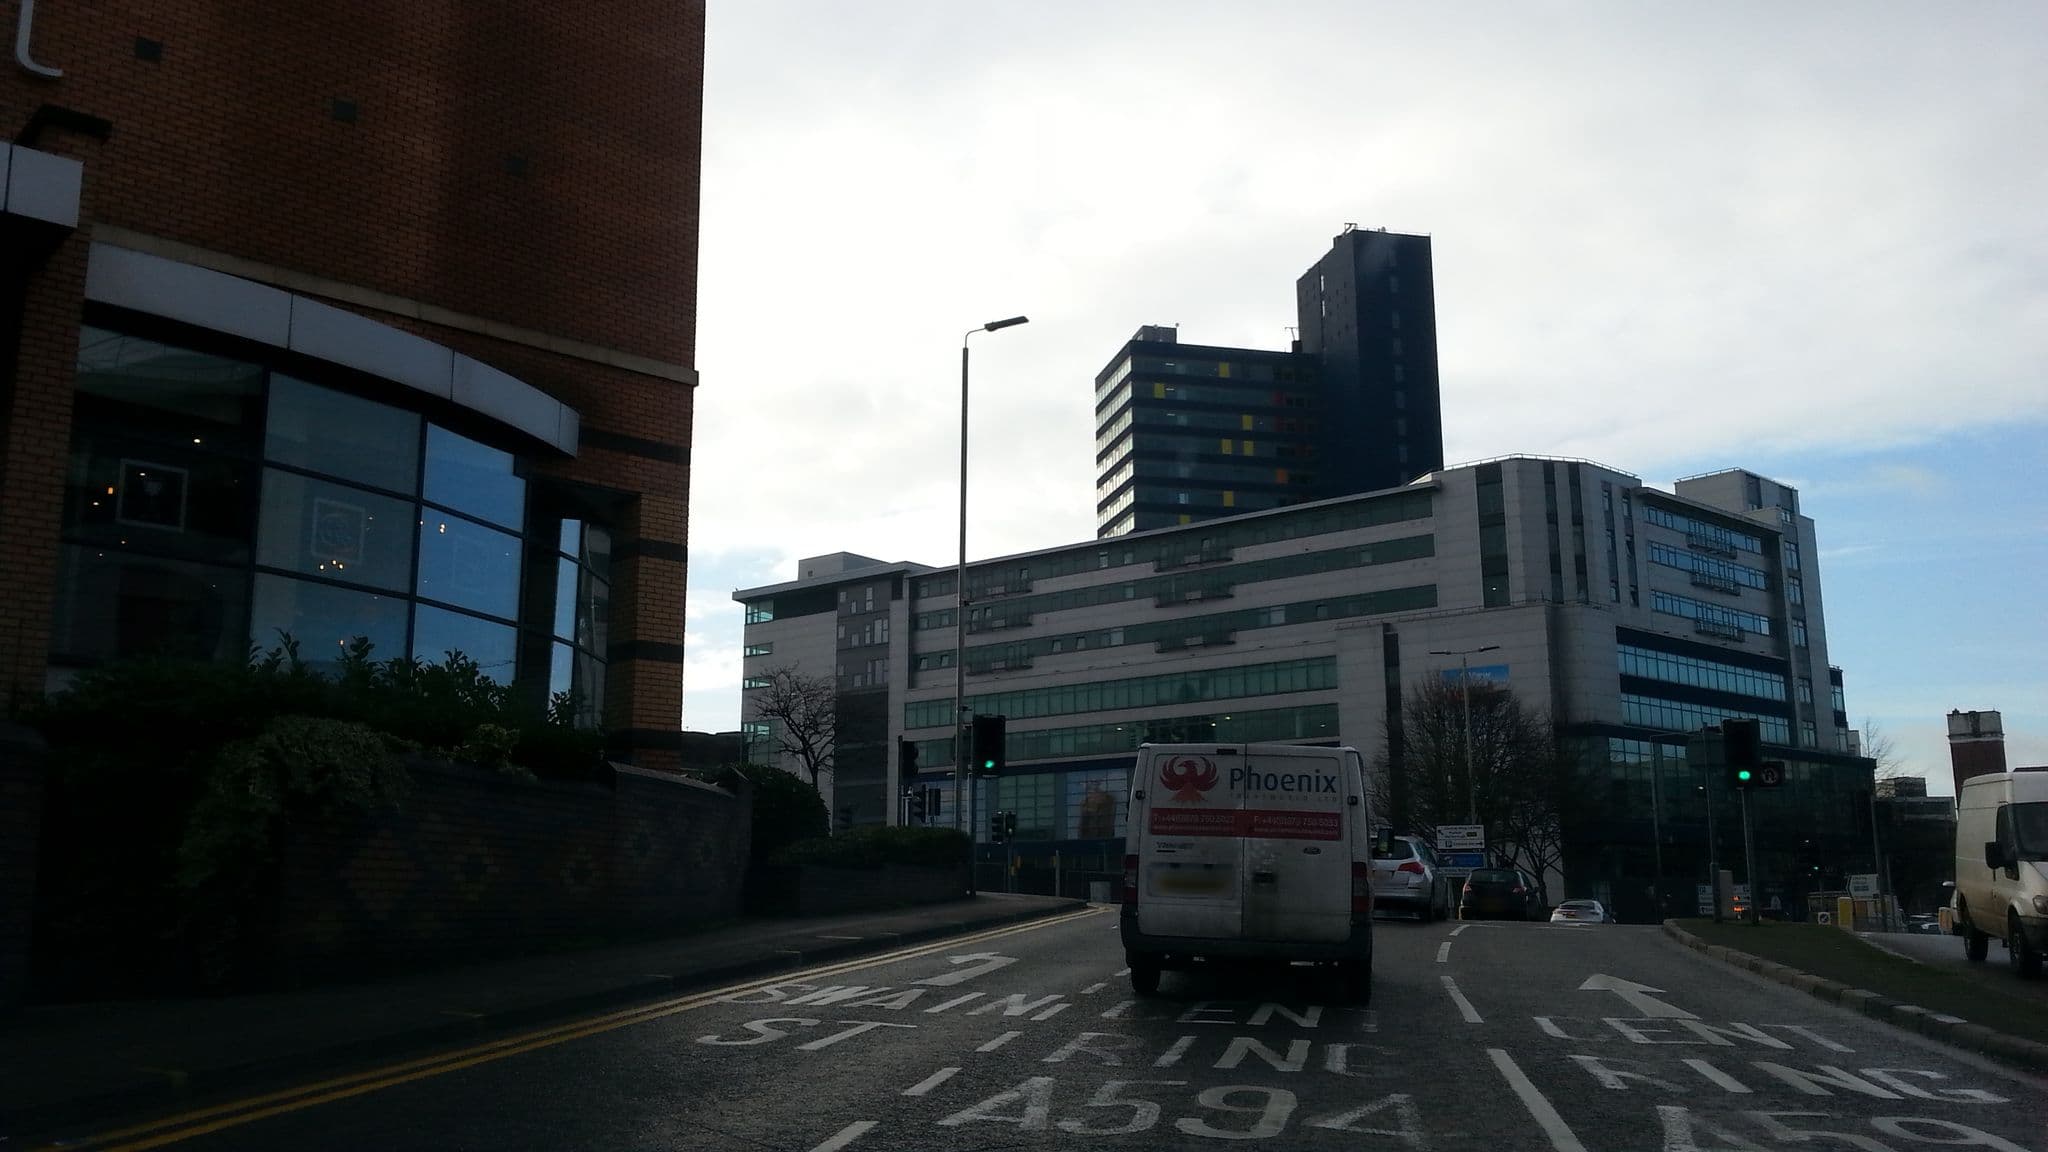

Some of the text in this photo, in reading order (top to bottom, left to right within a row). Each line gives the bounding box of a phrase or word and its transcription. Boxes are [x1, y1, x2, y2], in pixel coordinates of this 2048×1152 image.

[1229, 765, 1337, 793] Phoenix
[696, 1017, 918, 1051] ST
[1533, 1016, 1856, 1053] CENT
[1567, 1055, 2011, 1104] RING
[937, 1075, 1435, 1151] A594
